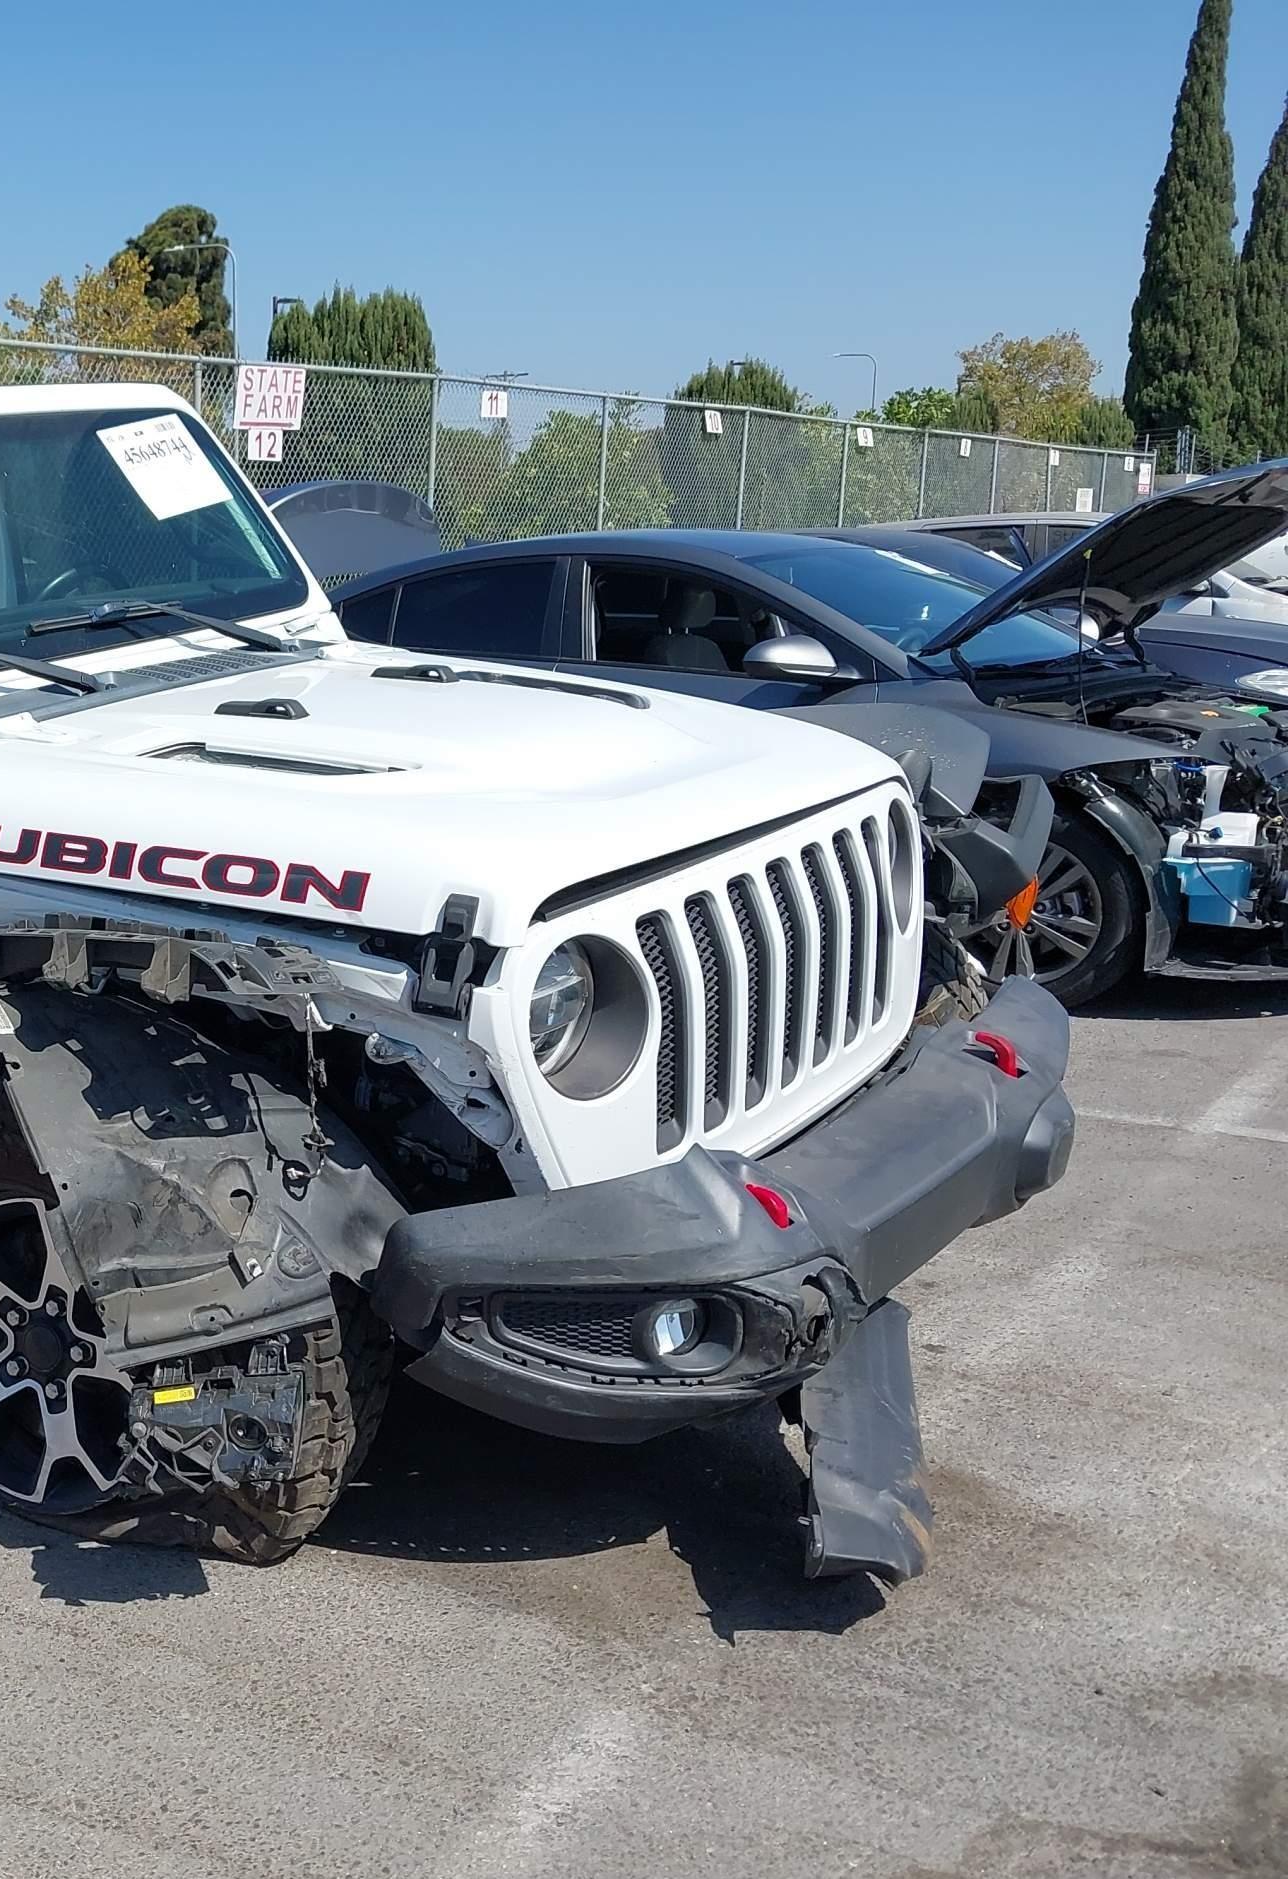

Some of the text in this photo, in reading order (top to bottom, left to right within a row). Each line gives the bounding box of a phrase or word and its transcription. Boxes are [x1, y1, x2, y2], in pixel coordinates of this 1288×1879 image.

[243, 368, 303, 394] STATE
[243, 394, 299, 419] FARM
[488, 392, 499, 415] 11
[255, 431, 277, 458] 12
